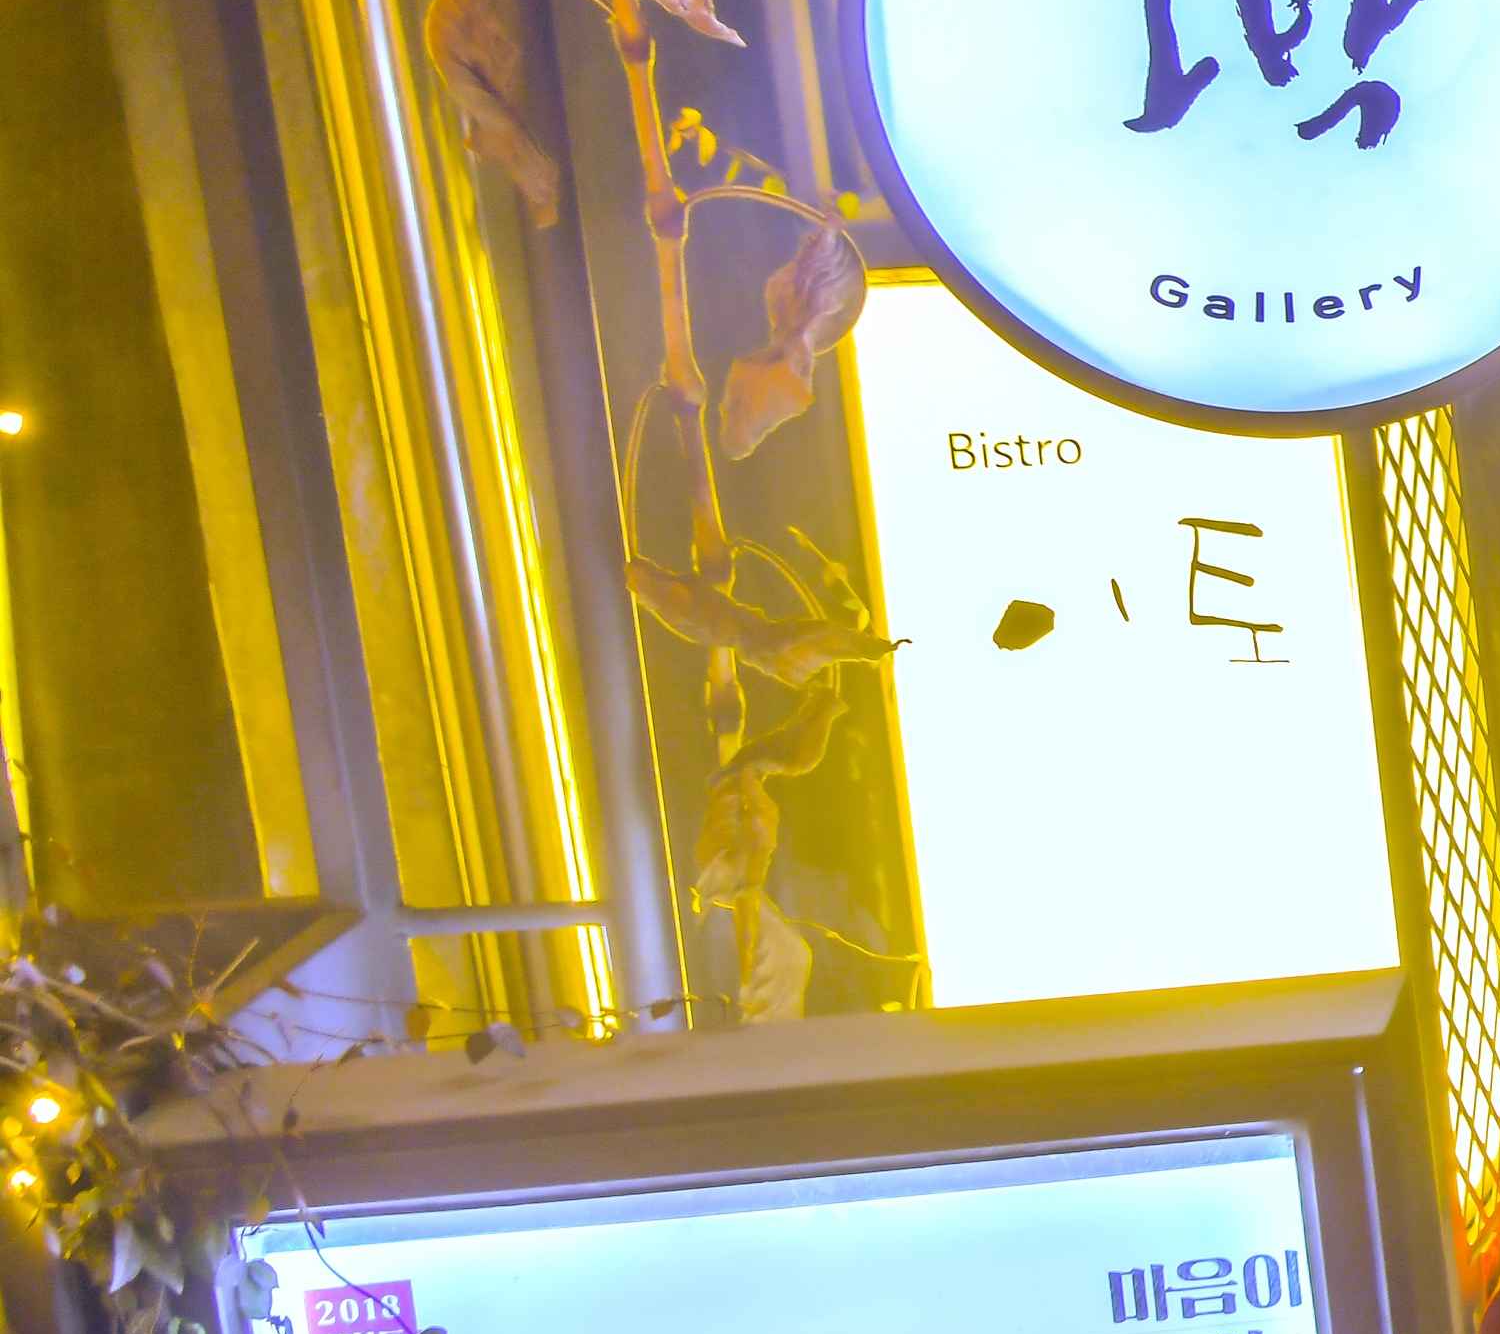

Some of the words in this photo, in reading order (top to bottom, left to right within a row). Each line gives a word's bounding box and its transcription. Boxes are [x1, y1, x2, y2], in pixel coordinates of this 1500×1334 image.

[1149, 265, 1425, 324] Gallery
[948, 431, 1083, 471] Bistro
[314, 1294, 401, 1326] 2018
[1108, 1250, 1302, 1323] 마음이
